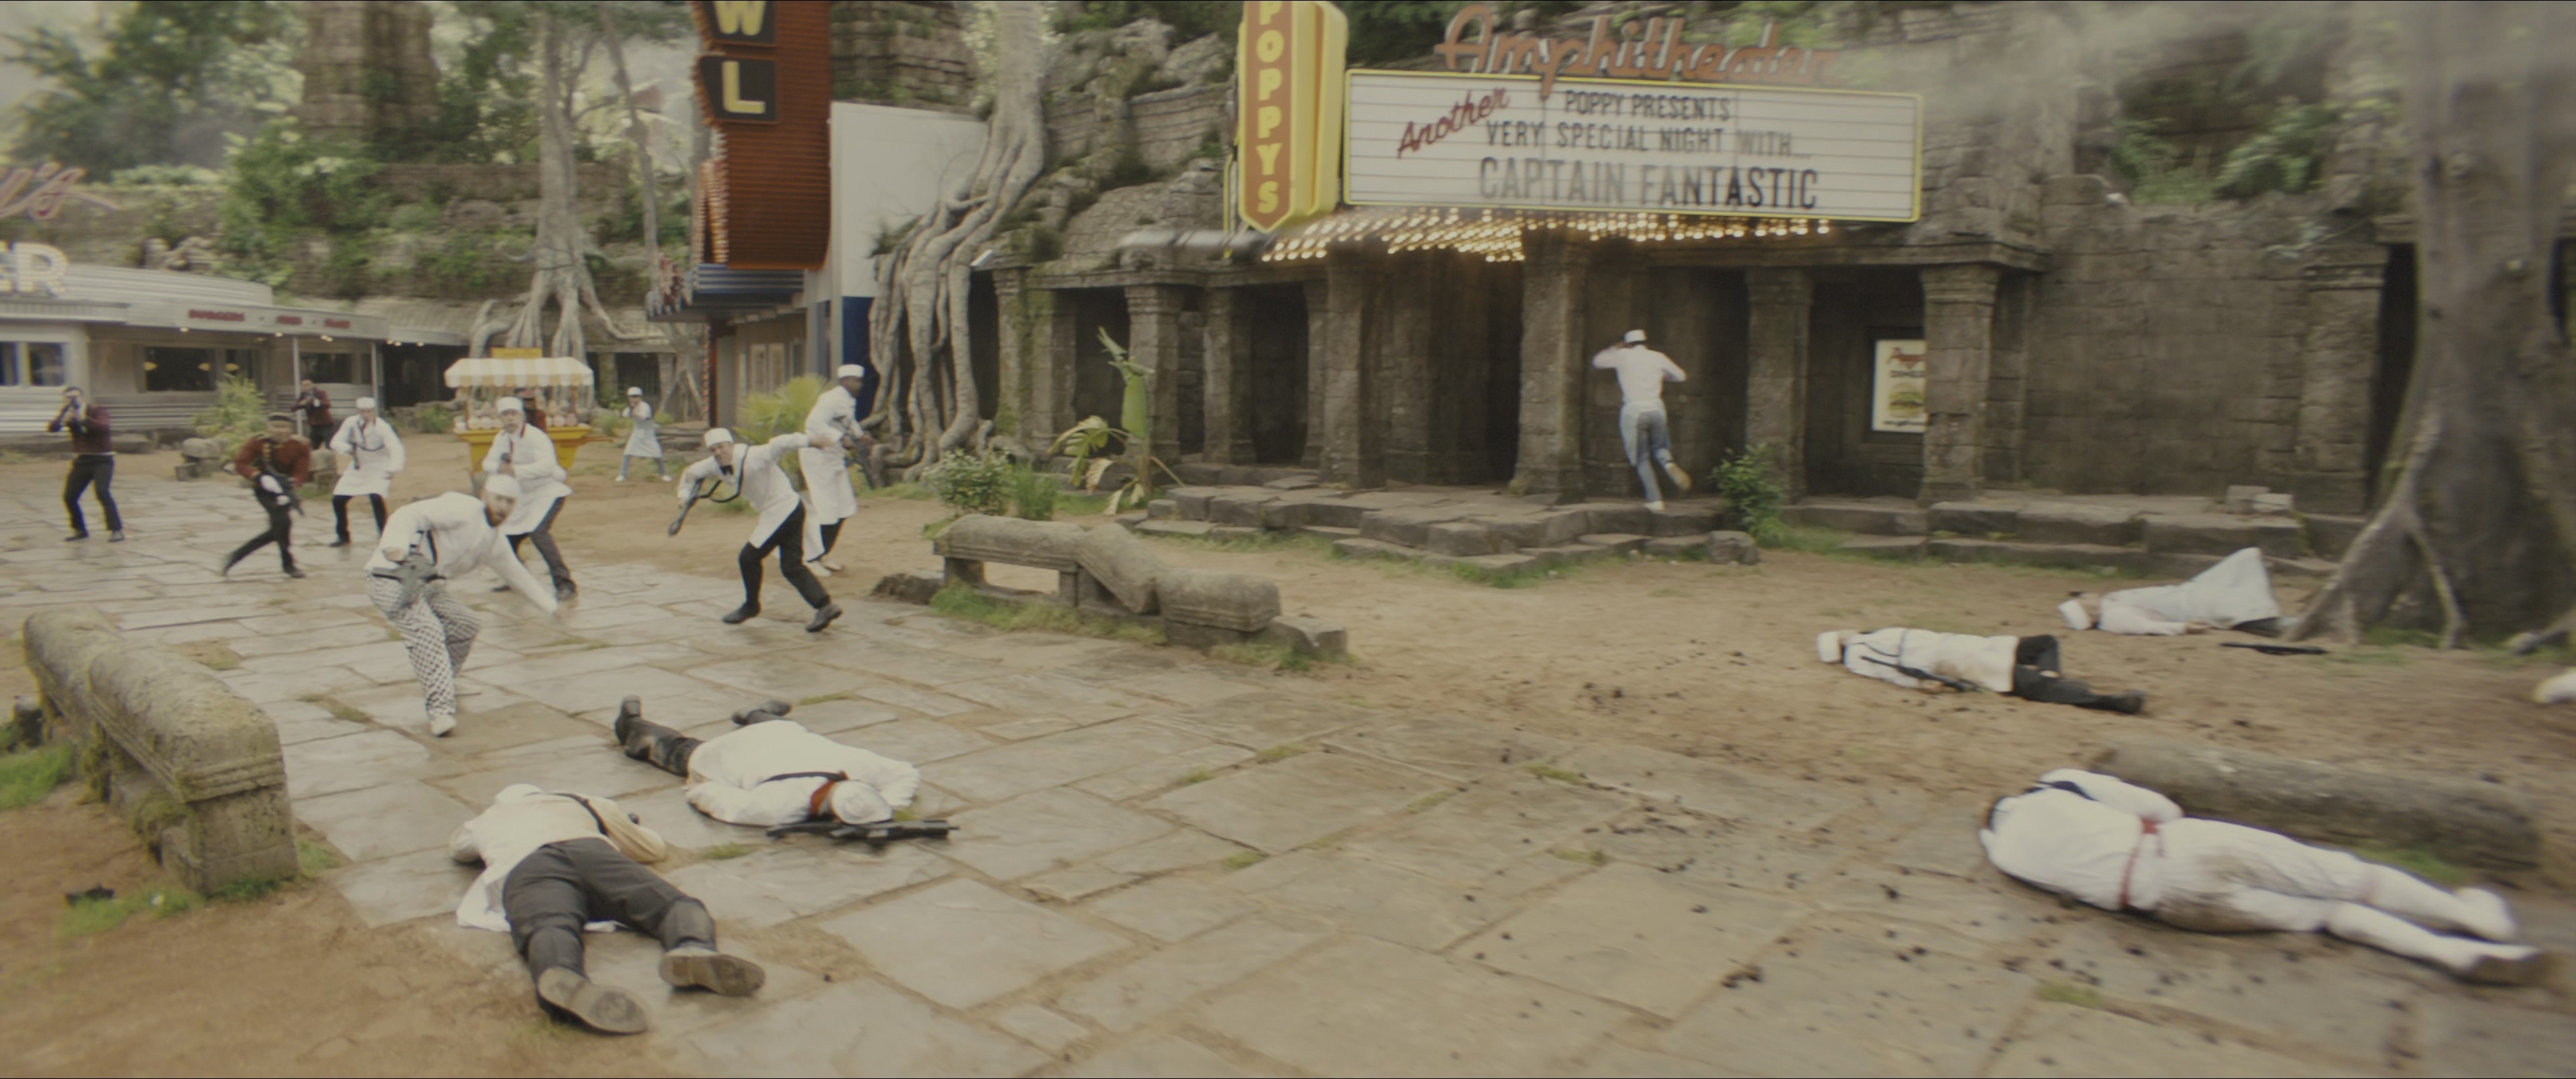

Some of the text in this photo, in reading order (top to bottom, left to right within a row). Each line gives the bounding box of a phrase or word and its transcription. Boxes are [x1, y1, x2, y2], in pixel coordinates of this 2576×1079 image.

[1397, 87, 1510, 158] Another
[1565, 90, 1730, 121] POPPY PRESENTS
[1487, 121, 1544, 146] VERY
[1556, 121, 1648, 151] SPECIAL
[1659, 127, 1723, 153] NIGHT
[1480, 156, 1818, 209] CAPTAIN FANTASTIC
